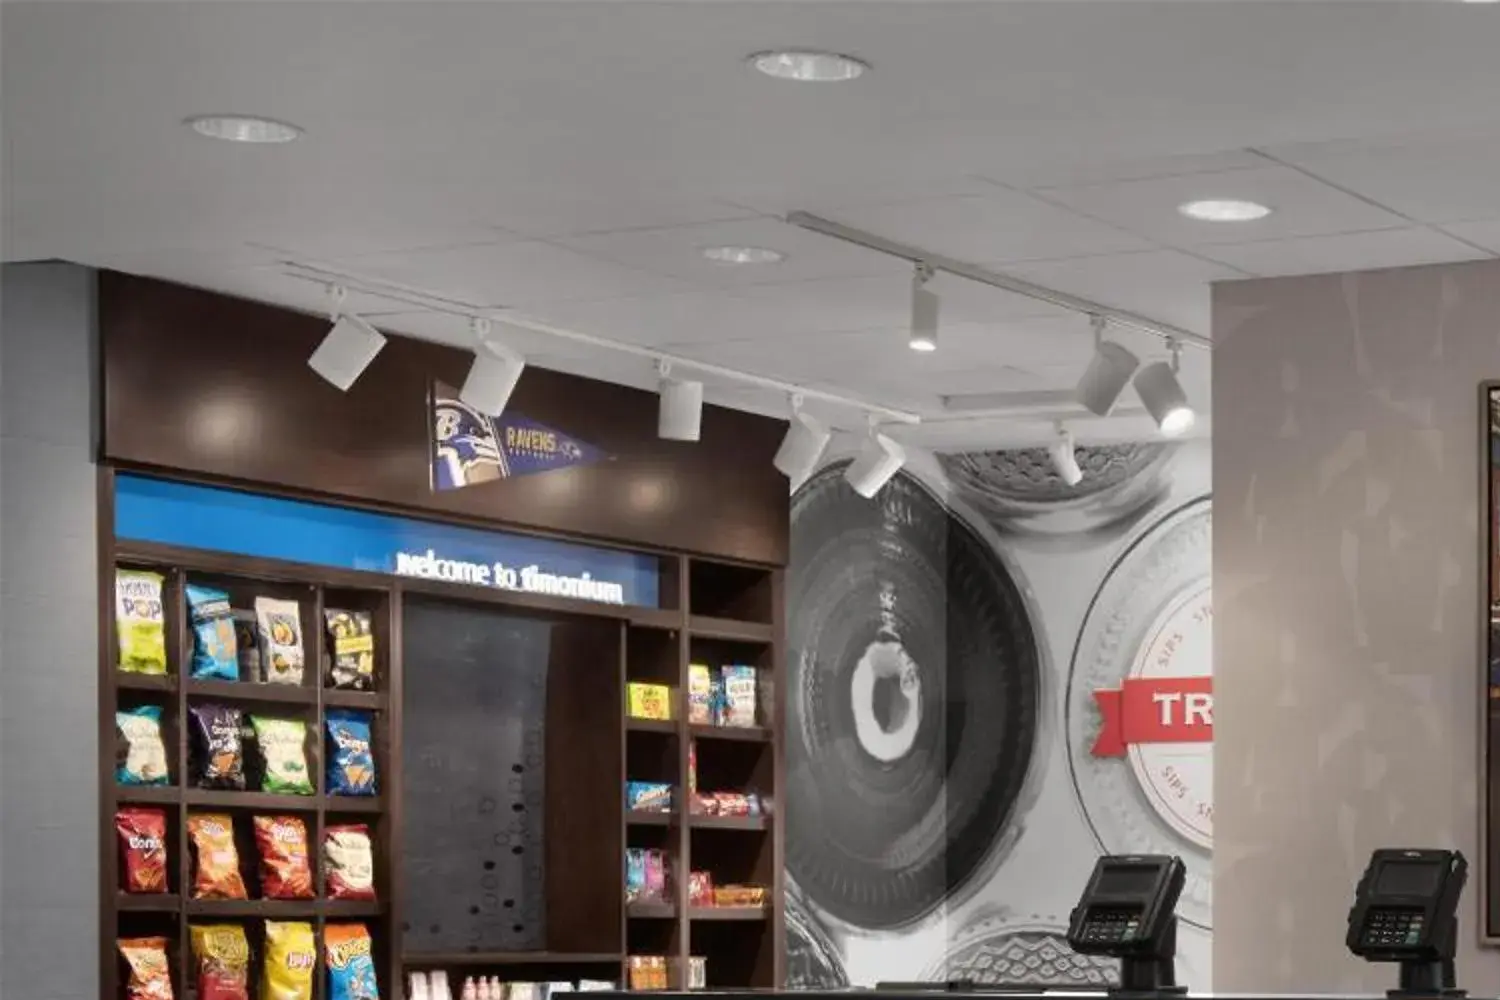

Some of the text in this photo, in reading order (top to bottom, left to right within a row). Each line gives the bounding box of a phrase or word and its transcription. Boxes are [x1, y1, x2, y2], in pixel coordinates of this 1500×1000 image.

[506, 426, 556, 452] RAVENS
[396, 549, 623, 604] welcome to timonium
[1158, 633, 1183, 667] SIPS
[1162, 765, 1189, 799] SIPS
